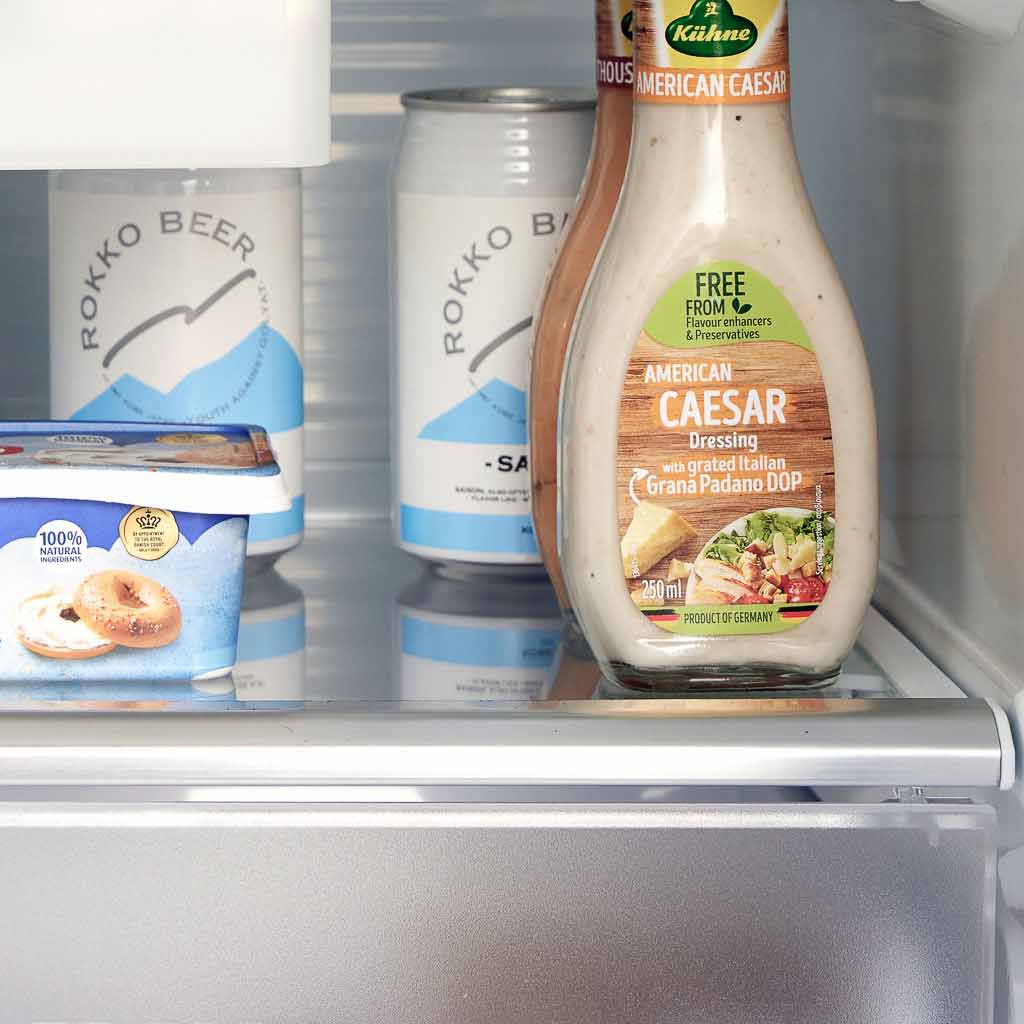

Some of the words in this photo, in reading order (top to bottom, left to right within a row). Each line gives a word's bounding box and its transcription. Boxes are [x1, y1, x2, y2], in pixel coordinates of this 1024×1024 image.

[672, 23, 751, 42] Kühne
[637, 71, 724, 97] AMERICAN
[728, 70, 786, 97] CAESAR
[80, 223, 141, 351] ROKKO
[160, 210, 255, 262] BEER
[442, 226, 513, 355] ROKKO
[695, 271, 746, 297] FREE
[686, 299, 725, 316] FROM
[686, 317, 722, 328] Flavour
[723, 316, 773, 328] enhancers
[685, 329, 694, 341] &
[695, 328, 760, 340] Preservatives
[644, 363, 732, 384] AMERICAN
[659, 388, 787, 428] CAESAR
[689, 431, 758, 452] Dressing
[662, 461, 686, 473] with
[687, 456, 736, 477] grated
[739, 456, 786, 472] Italian
[646, 474, 697, 495] Grana
[700, 474, 763, 494] Padano
[767, 472, 802, 492] DOP
[39, 530, 82, 546] 100%
[40, 547, 82, 556] NATURAL
[40, 556, 82, 564] INGREDIENTS
[641, 580, 664, 599] 250
[665, 580, 682, 599] ml
[684, 612, 721, 625] PRODUCT
[722, 612, 733, 624] OF
[734, 611, 773, 624] GERMANY
